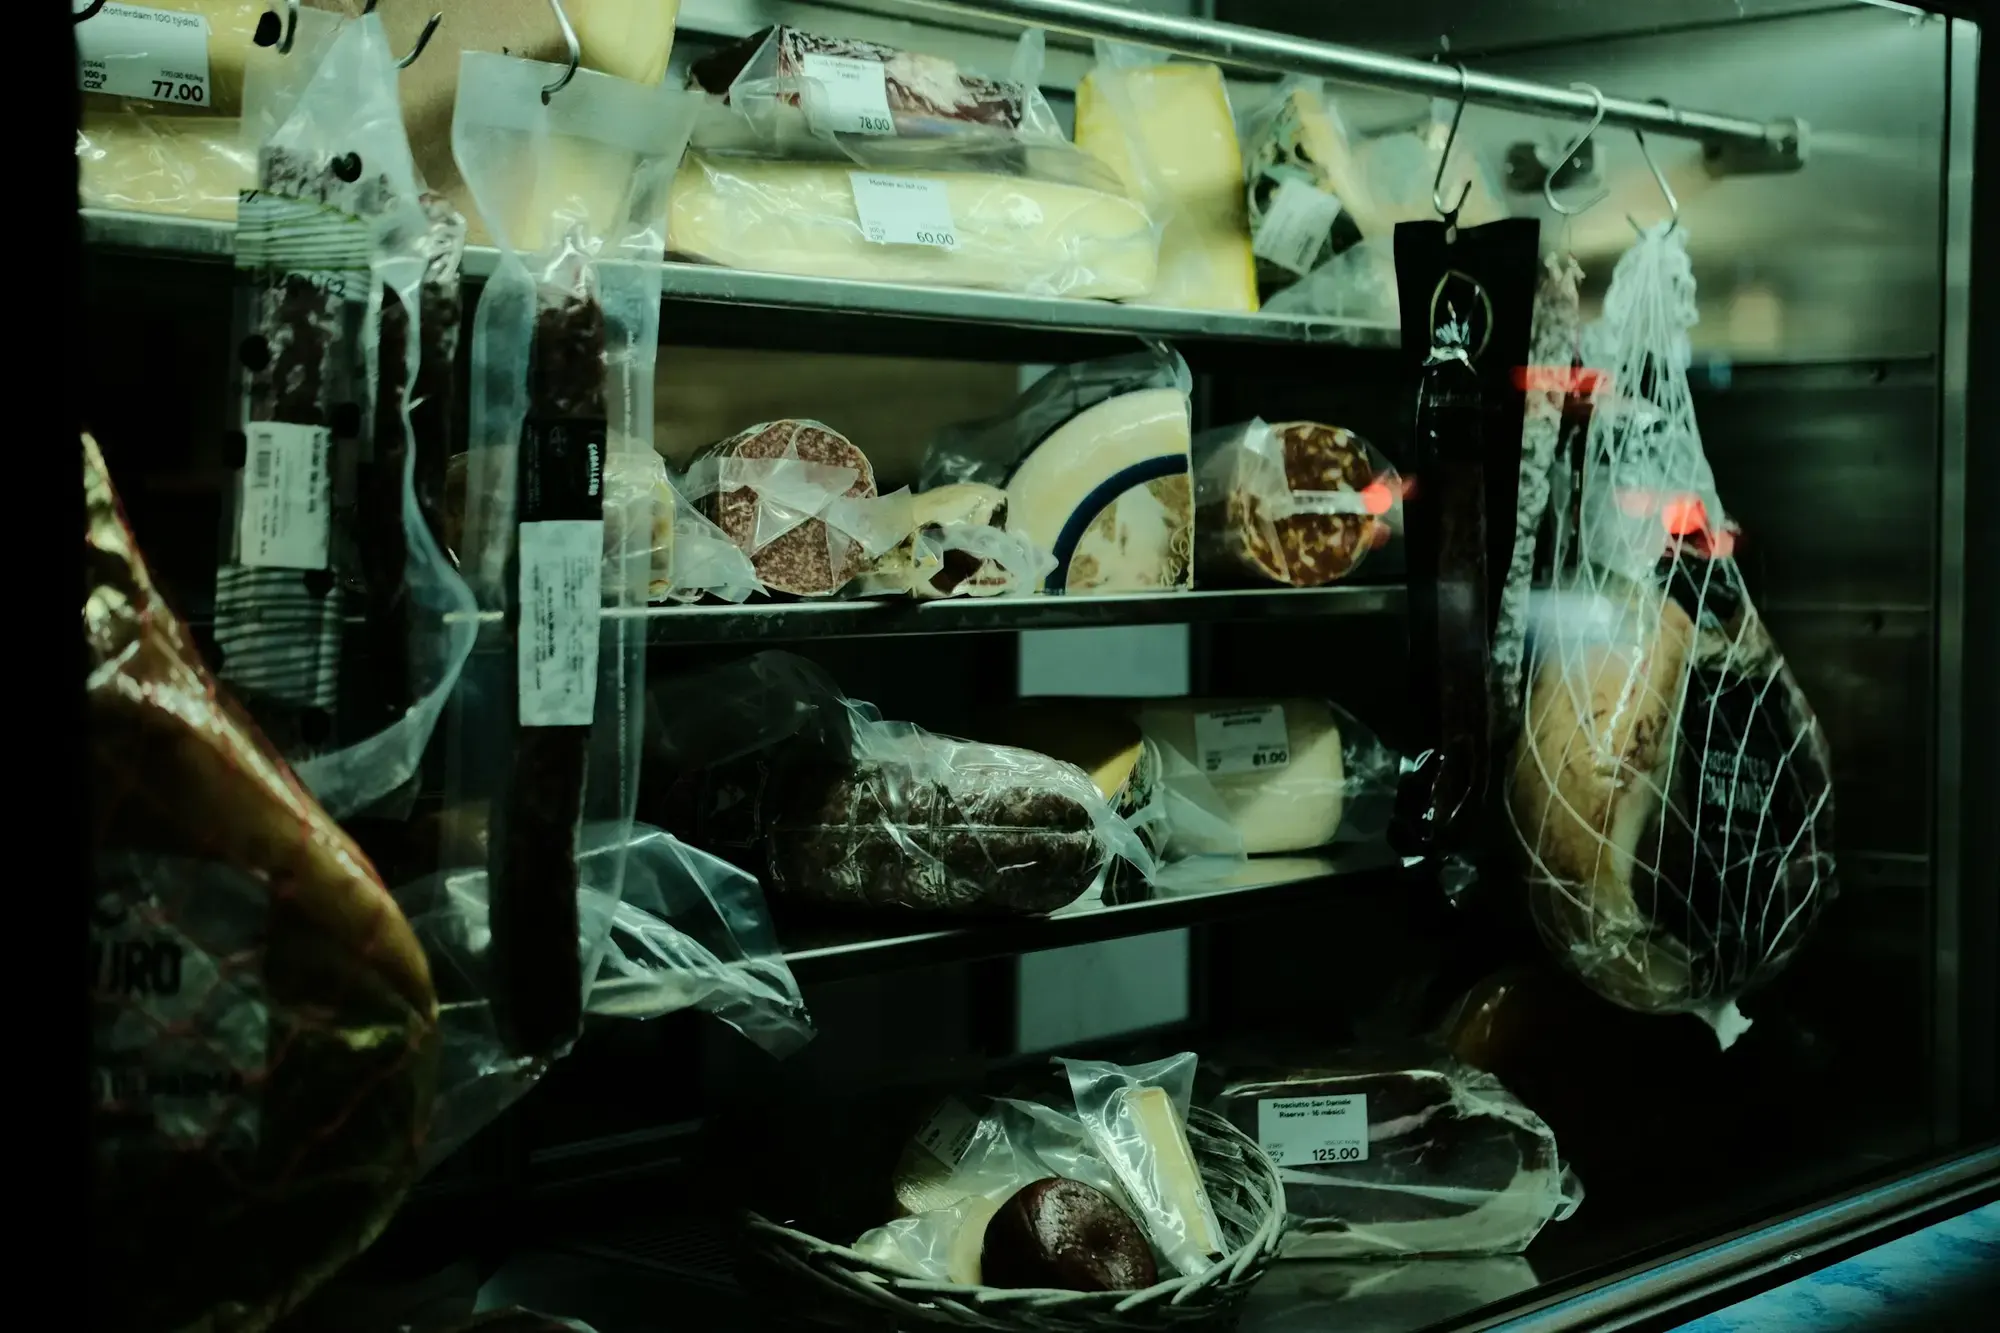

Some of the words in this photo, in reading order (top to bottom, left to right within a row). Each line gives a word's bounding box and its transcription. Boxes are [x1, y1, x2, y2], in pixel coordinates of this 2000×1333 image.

[102, 5, 152, 21] Rotterdam
[154, 13, 171, 24] 100
[172, 16, 200, 28] týdnů
[84, 70, 99, 79] 100
[101, 74, 107, 82] g
[84, 80, 103, 89] CZK
[152, 80, 204, 102] 77.00
[858, 116, 890, 131] 78.00
[916, 231, 954, 245] 60.00
[1273, 1101, 1310, 1110] Prosciutto
[1311, 1100, 1324, 1108] San
[1326, 1099, 1352, 1107] Daniele
[1279, 1111, 1305, 1119] Riserva
[1312, 1147, 1360, 1161] 125.00
